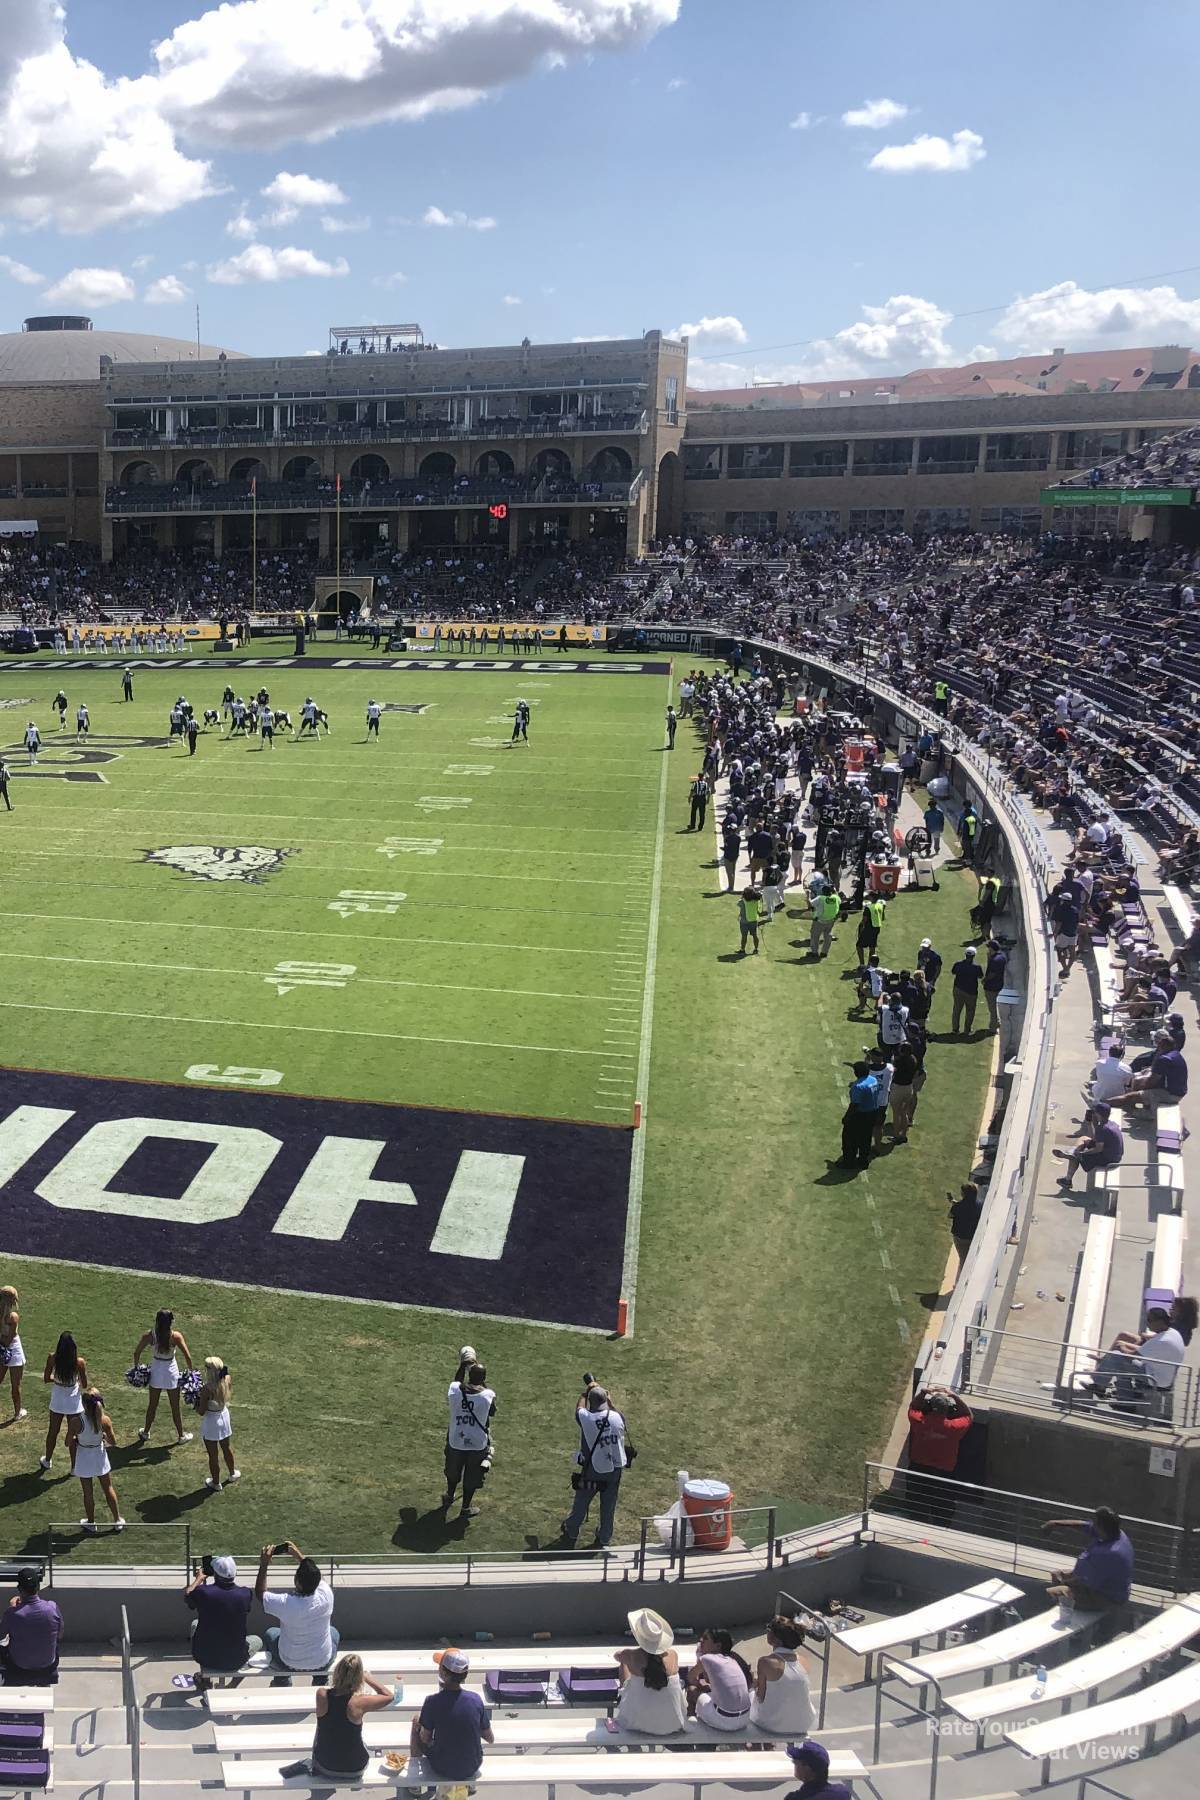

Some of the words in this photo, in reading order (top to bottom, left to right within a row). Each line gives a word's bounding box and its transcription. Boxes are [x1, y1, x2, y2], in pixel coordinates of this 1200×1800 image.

[489, 504, 506, 518] 40
[331, 659, 645, 672] FROGS
[880, 871, 894, 885] G
[327, 890, 408, 914] 20
[264, 960, 357, 987] 10
[184, 1063, 284, 1086] G
[456, 1415, 475, 1427] TCU
[598, 1434, 618, 1449] TCU
[712, 1508, 725, 1524] G
